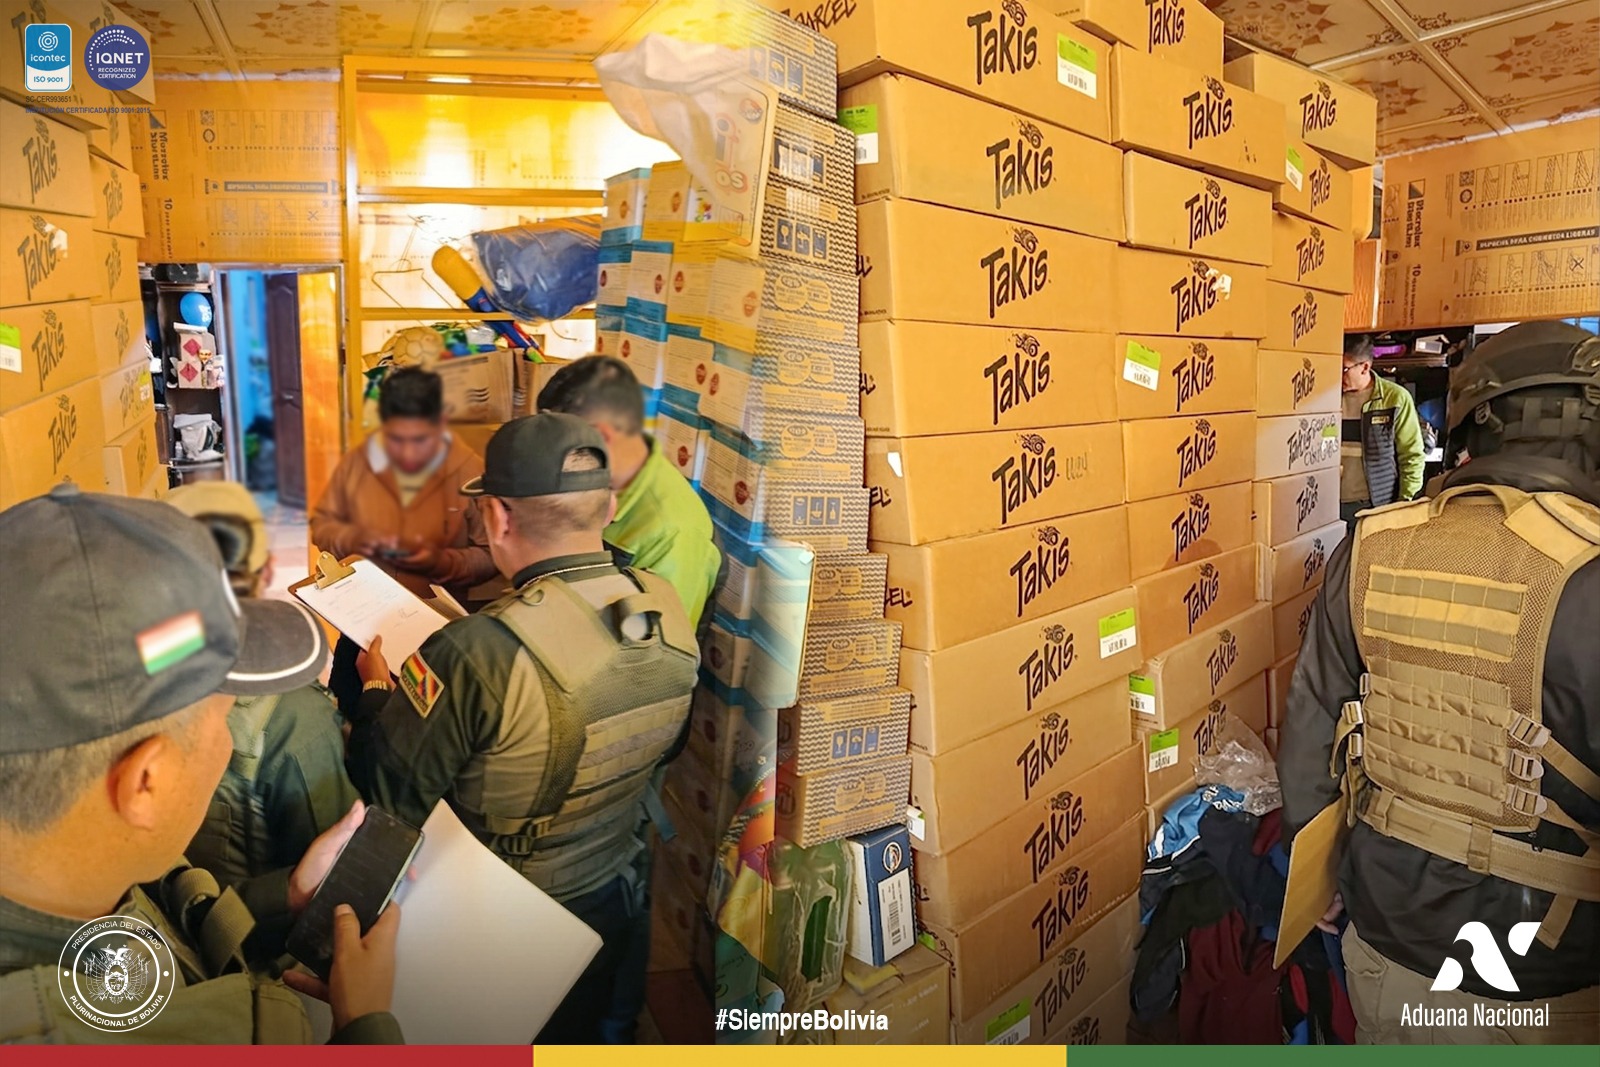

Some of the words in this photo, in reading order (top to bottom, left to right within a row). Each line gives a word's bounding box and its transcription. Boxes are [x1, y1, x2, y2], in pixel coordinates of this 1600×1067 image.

[967, 10, 1038, 85] Takis
[1145, 0, 1185, 54] Takis
[1183, 91, 1233, 149] Takis
[1299, 93, 1337, 139] Takis
[22, 136, 58, 204] Takis
[986, 138, 1053, 209] Takis
[1184, 193, 1228, 249] Takis
[981, 247, 1048, 318] Takis
[1171, 275, 1217, 333] Takis
[32, 322, 65, 392] Takis
[984, 351, 1050, 425] Takis
[1172, 355, 1214, 412] Takis
[48, 404, 77, 475] Takis
[1177, 429, 1216, 488] Takis
[991, 447, 1056, 524] Takis
[1171, 502, 1210, 561] Takis
[1009, 537, 1069, 617] Takis
[1183, 570, 1219, 635] Takis
[1018, 633, 1074, 711] Takis
[1206, 635, 1237, 696] Takis
[1016, 718, 1069, 800] Takis
[1024, 796, 1082, 883] Takis
[1031, 870, 1088, 963] Takis
[1034, 950, 1086, 1037] Takis
